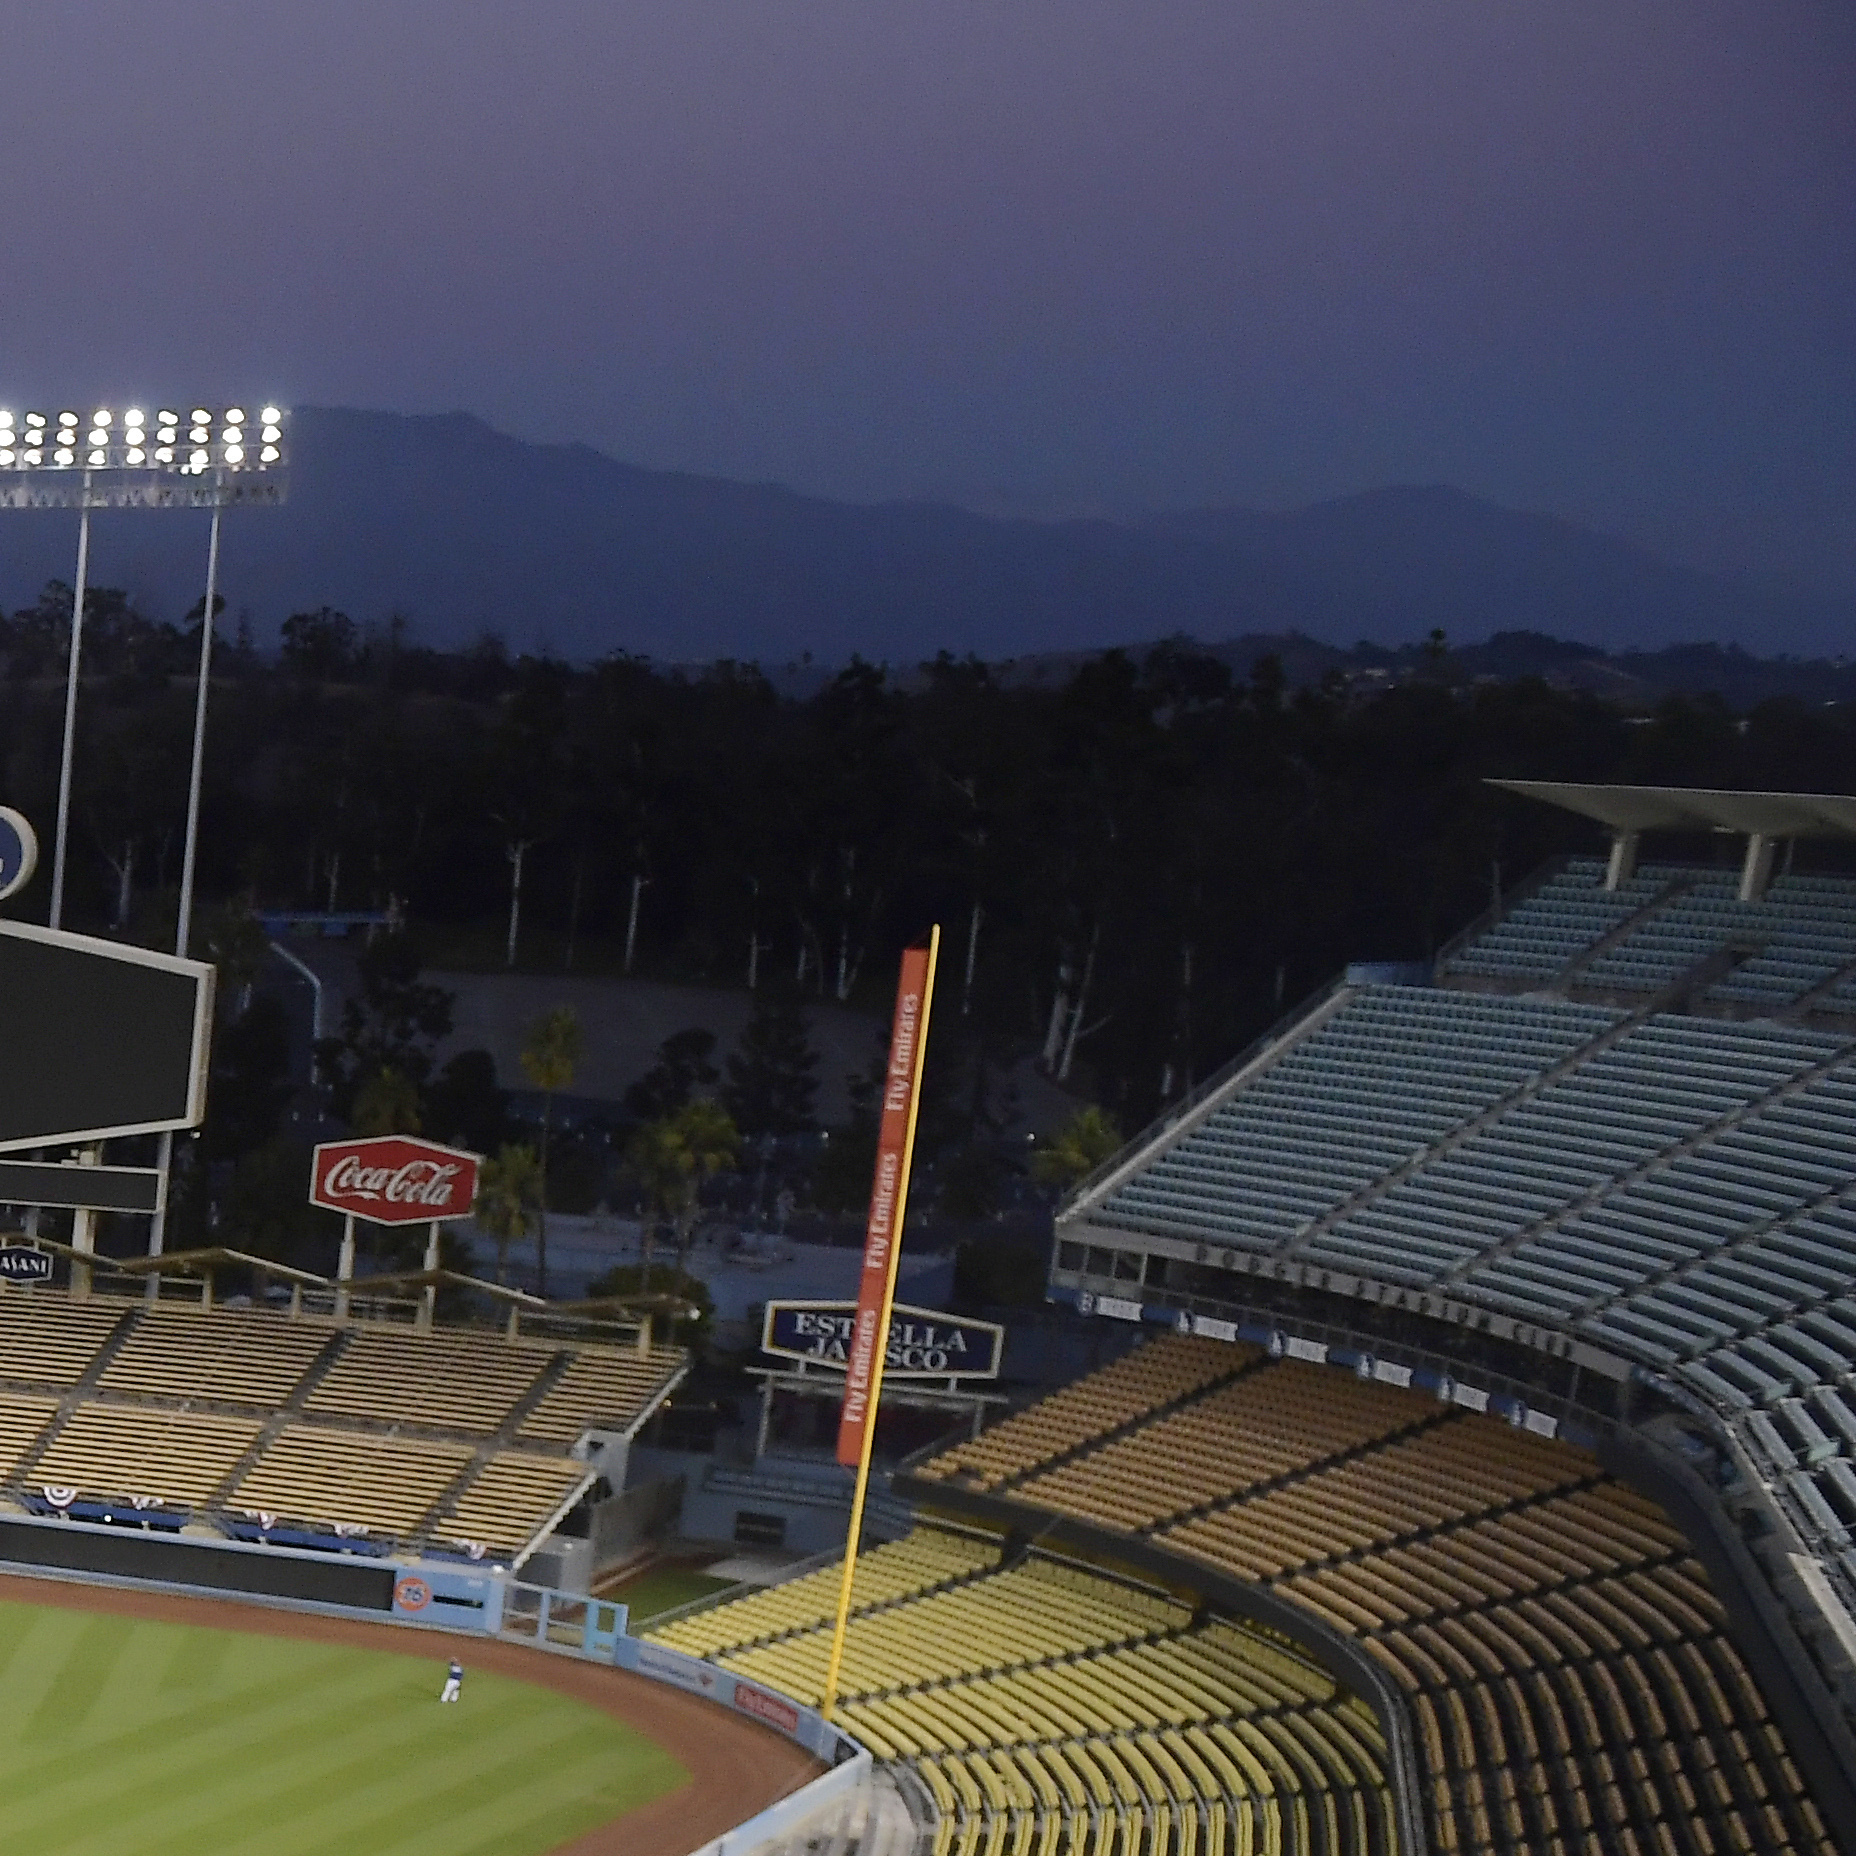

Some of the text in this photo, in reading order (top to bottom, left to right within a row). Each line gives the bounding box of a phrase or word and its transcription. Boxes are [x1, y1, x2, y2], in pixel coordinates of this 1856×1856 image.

[886, 1080, 910, 1111] Fly
[866, 1235, 889, 1268] Fly
[795, 1312, 968, 1352] ESTELLA
[808, 1337, 948, 1371] JASCO
[843, 1390, 869, 1423] Fly
